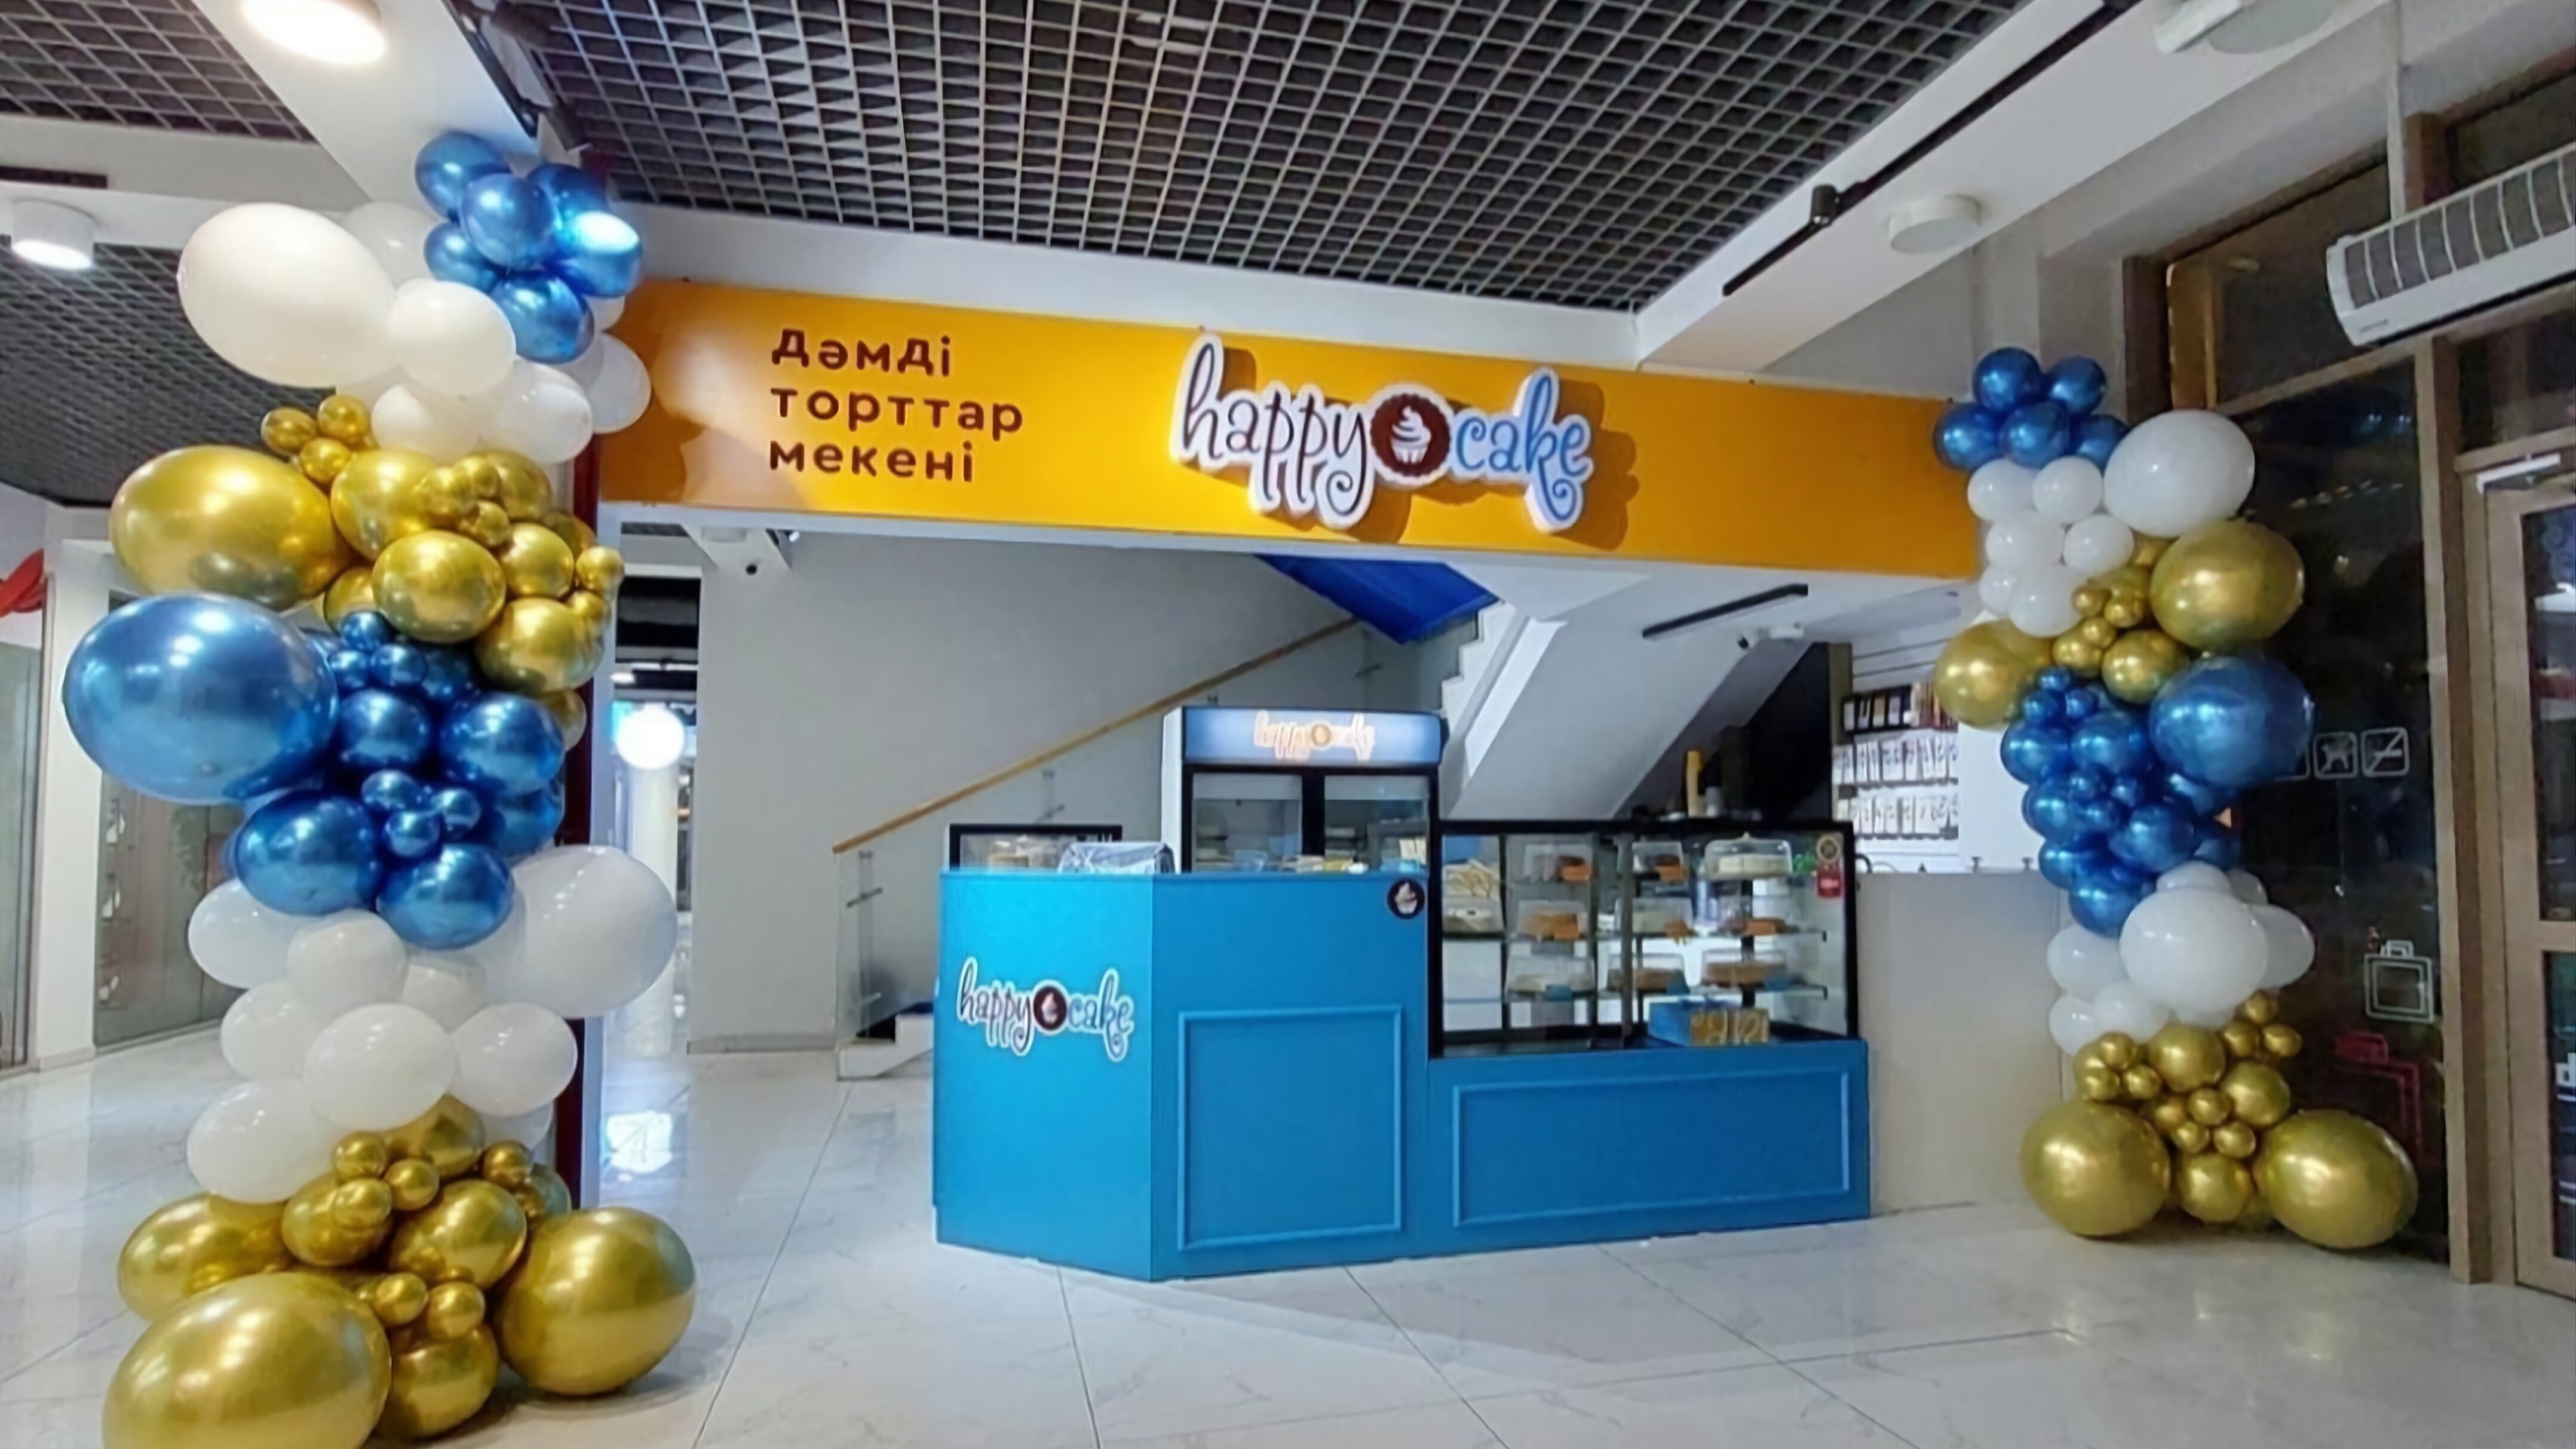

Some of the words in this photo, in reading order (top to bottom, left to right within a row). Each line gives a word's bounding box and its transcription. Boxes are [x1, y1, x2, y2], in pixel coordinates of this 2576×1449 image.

[770, 387, 1023, 443] торттар
[1180, 340, 1369, 517] happy
[1453, 371, 1593, 524] cake
[769, 440, 974, 483] мекені
[959, 959, 1033, 1054] happy
[1068, 971, 1132, 1060] cake
